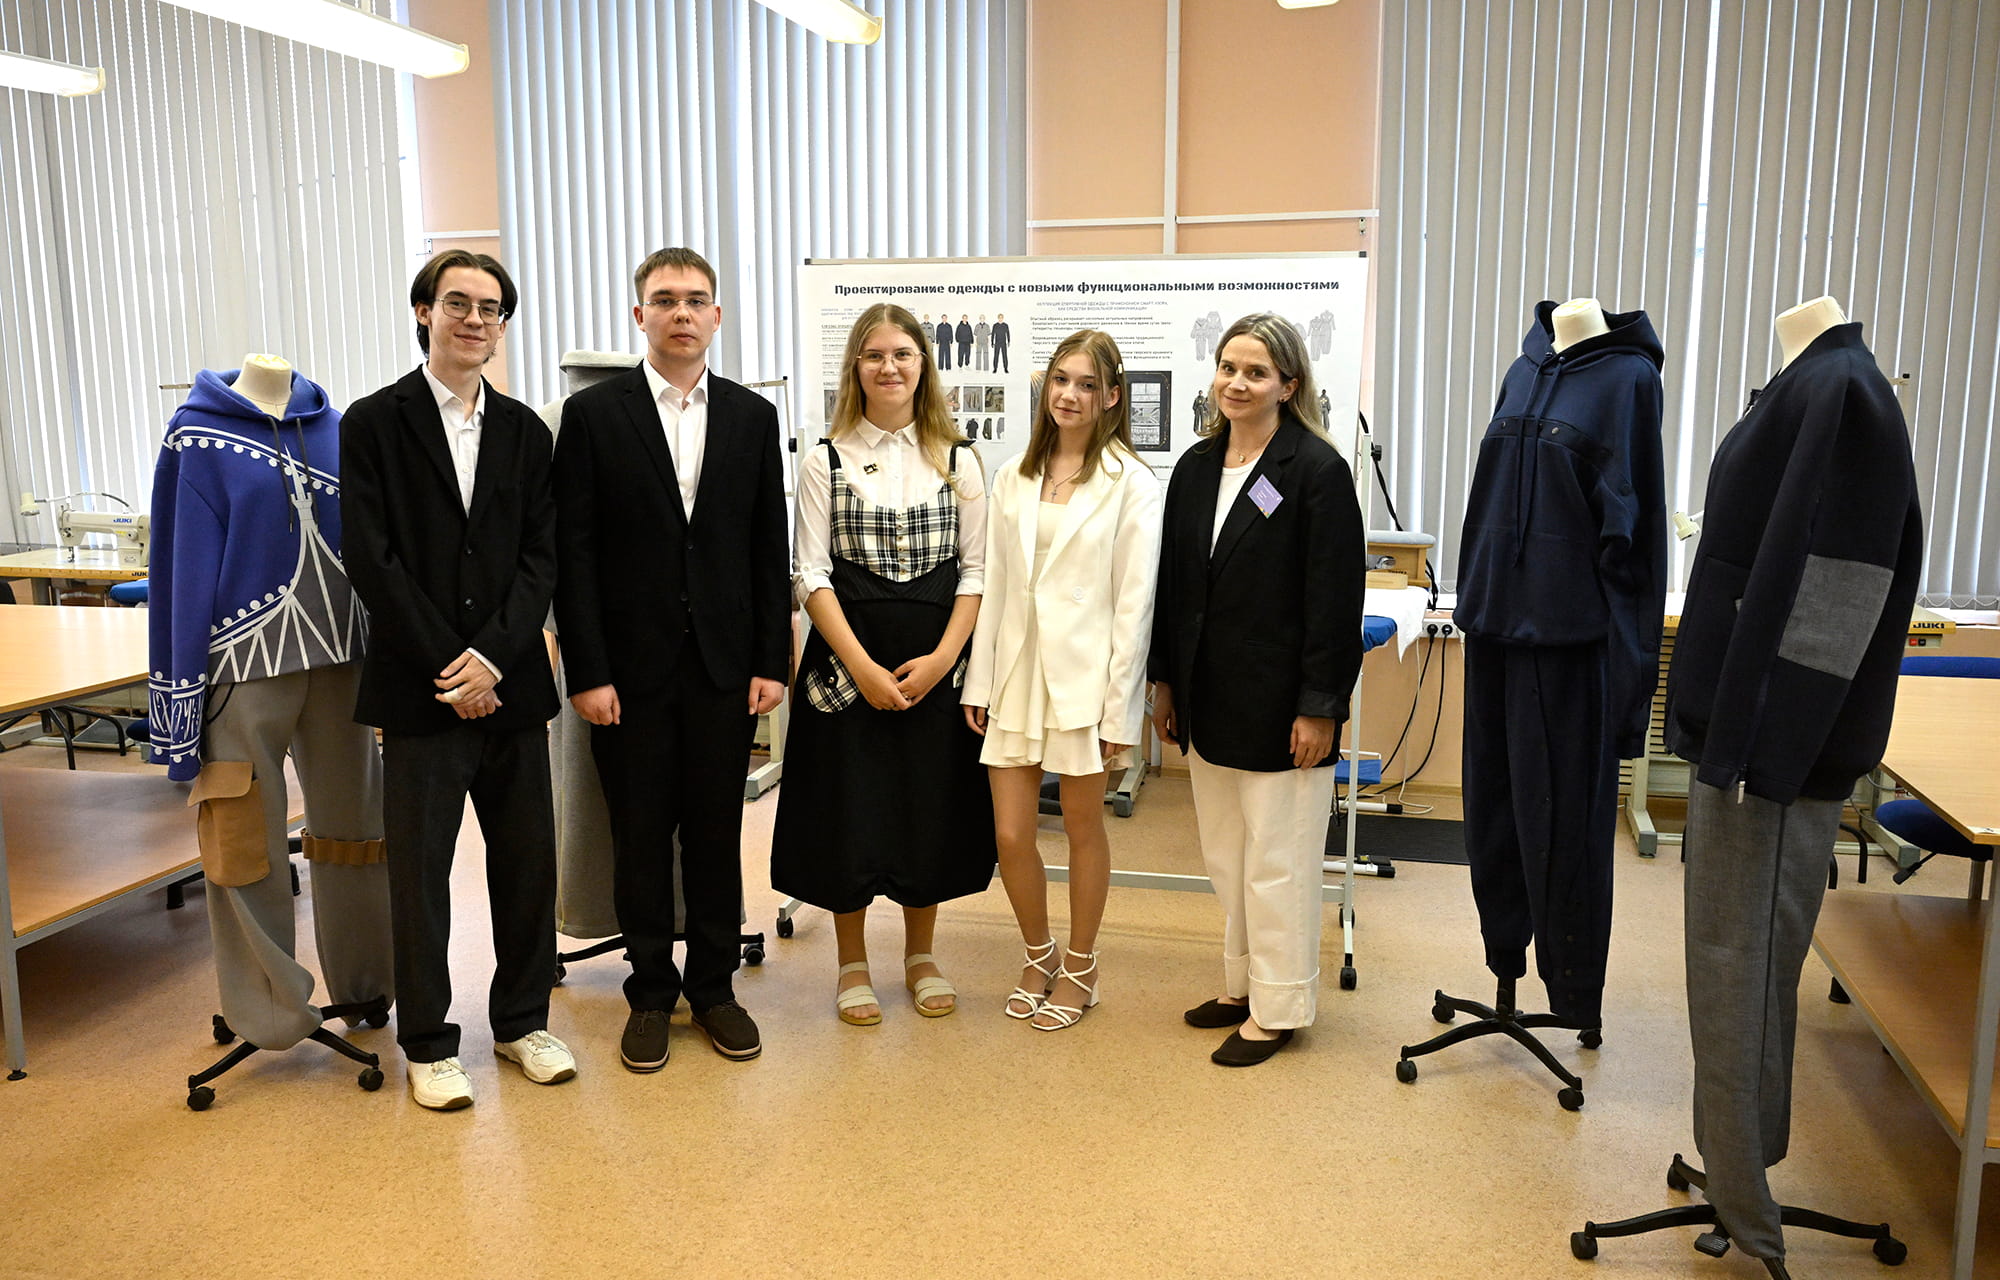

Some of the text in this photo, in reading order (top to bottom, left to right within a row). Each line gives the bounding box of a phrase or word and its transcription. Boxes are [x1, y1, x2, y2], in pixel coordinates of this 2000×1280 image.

[835, 281, 1340, 296] Проектирование одежды с новыми функциональными возможностями
